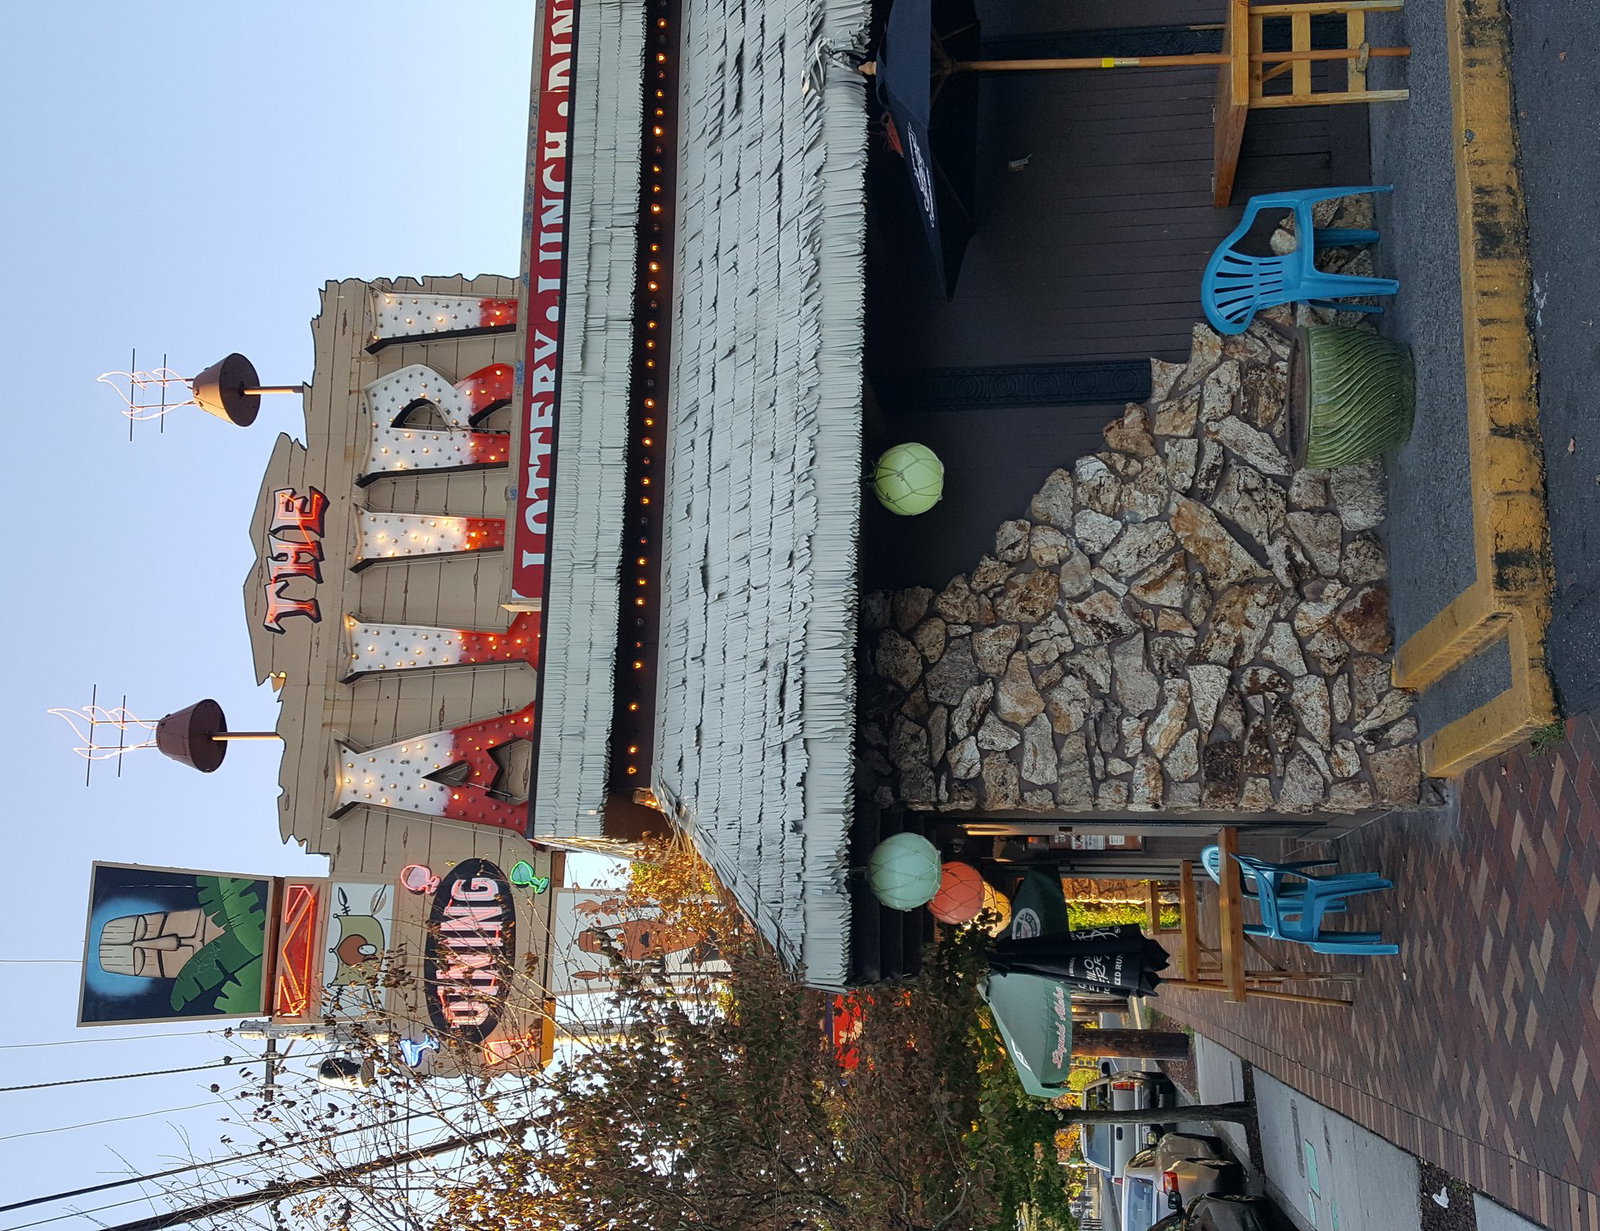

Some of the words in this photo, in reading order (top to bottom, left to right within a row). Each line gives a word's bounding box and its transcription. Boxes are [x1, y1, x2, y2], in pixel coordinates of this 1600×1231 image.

[547, 0, 574, 92] DIN
[262, 486, 331, 634] THE
[328, 286, 541, 839] ALIBI
[436, 877, 504, 1028] DINING
